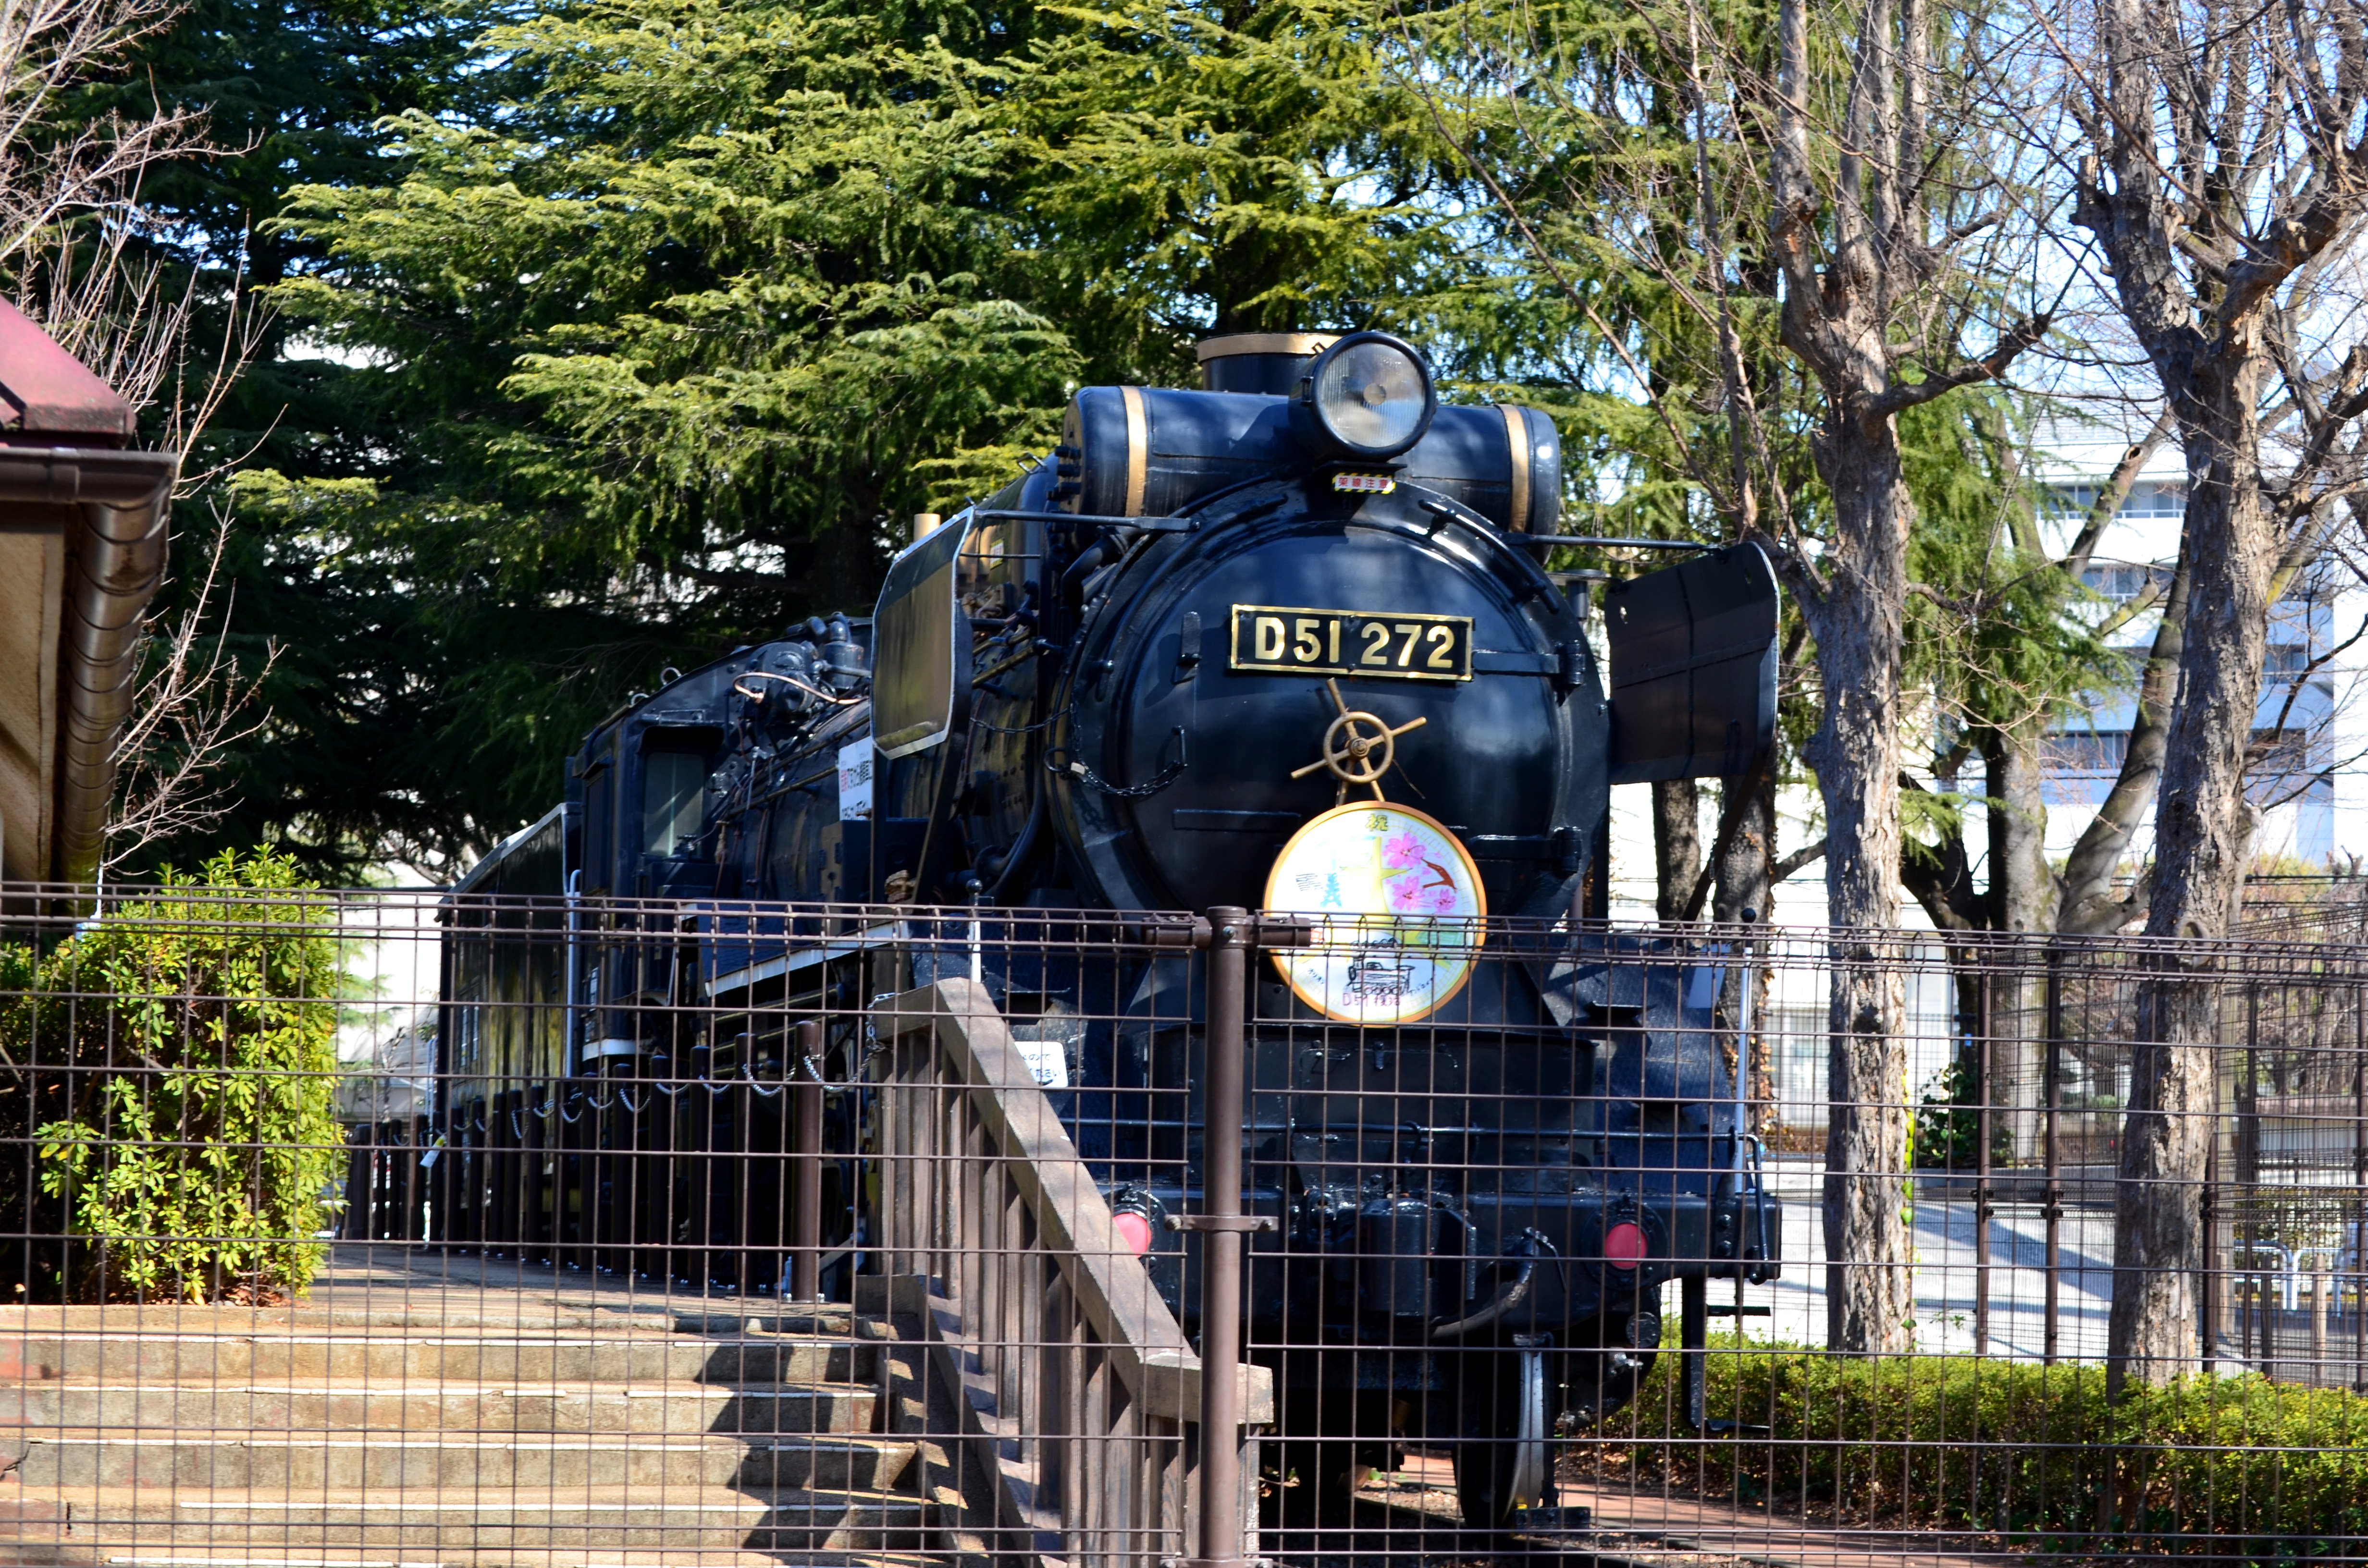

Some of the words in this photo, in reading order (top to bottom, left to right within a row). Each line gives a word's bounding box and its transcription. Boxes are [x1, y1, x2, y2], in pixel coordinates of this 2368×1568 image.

[1338, 477, 1389, 489] 架線注意
[1255, 617, 1341, 663] D51
[1361, 622, 1455, 668] 272
